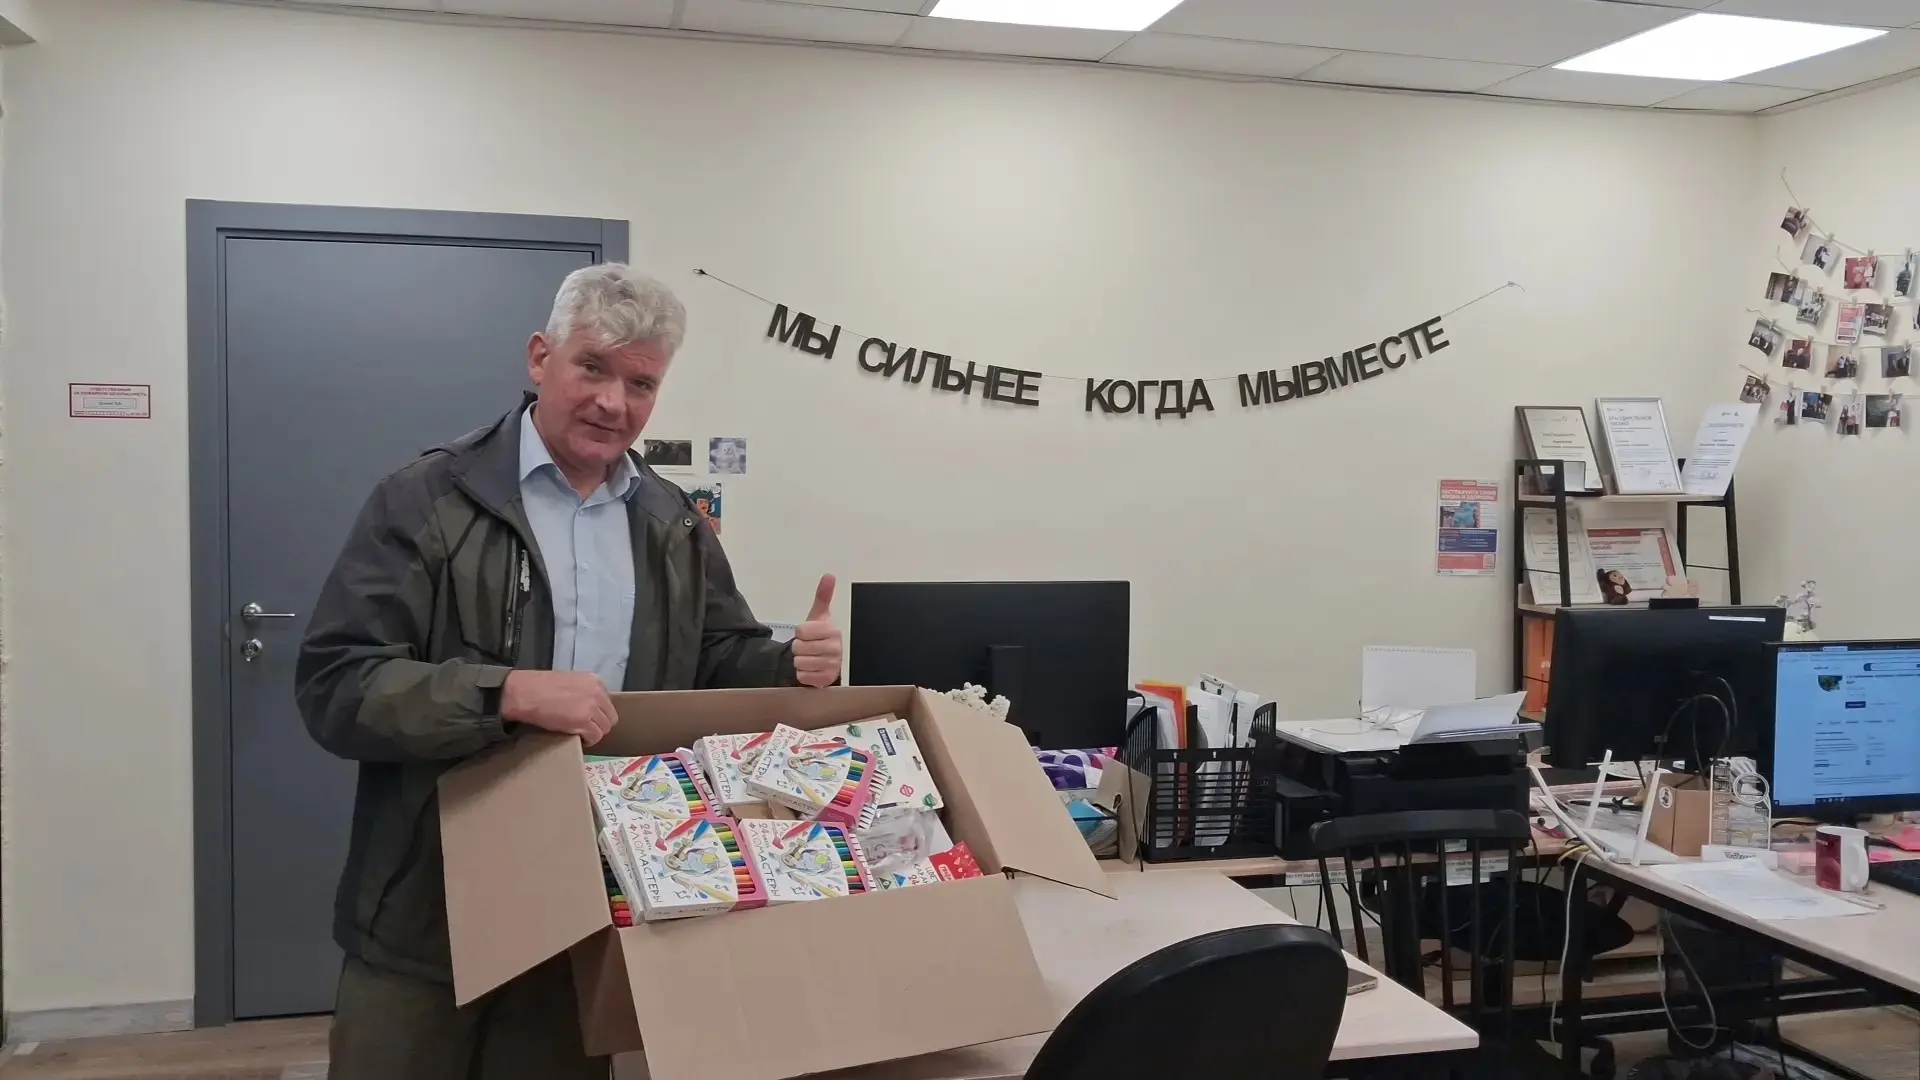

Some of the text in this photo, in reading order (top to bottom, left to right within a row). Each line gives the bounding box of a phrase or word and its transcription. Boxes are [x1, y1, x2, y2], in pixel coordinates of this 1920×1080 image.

[767, 303, 841, 360] МЫ
[858, 337, 1042, 406] СИЛЬНЕЕ
[1085, 377, 1214, 420] КОГДА
[628, 823, 663, 903] ФЛОМАСТЕРЫ
[748, 822, 780, 896] ФЛОМАСТЕРЫ
